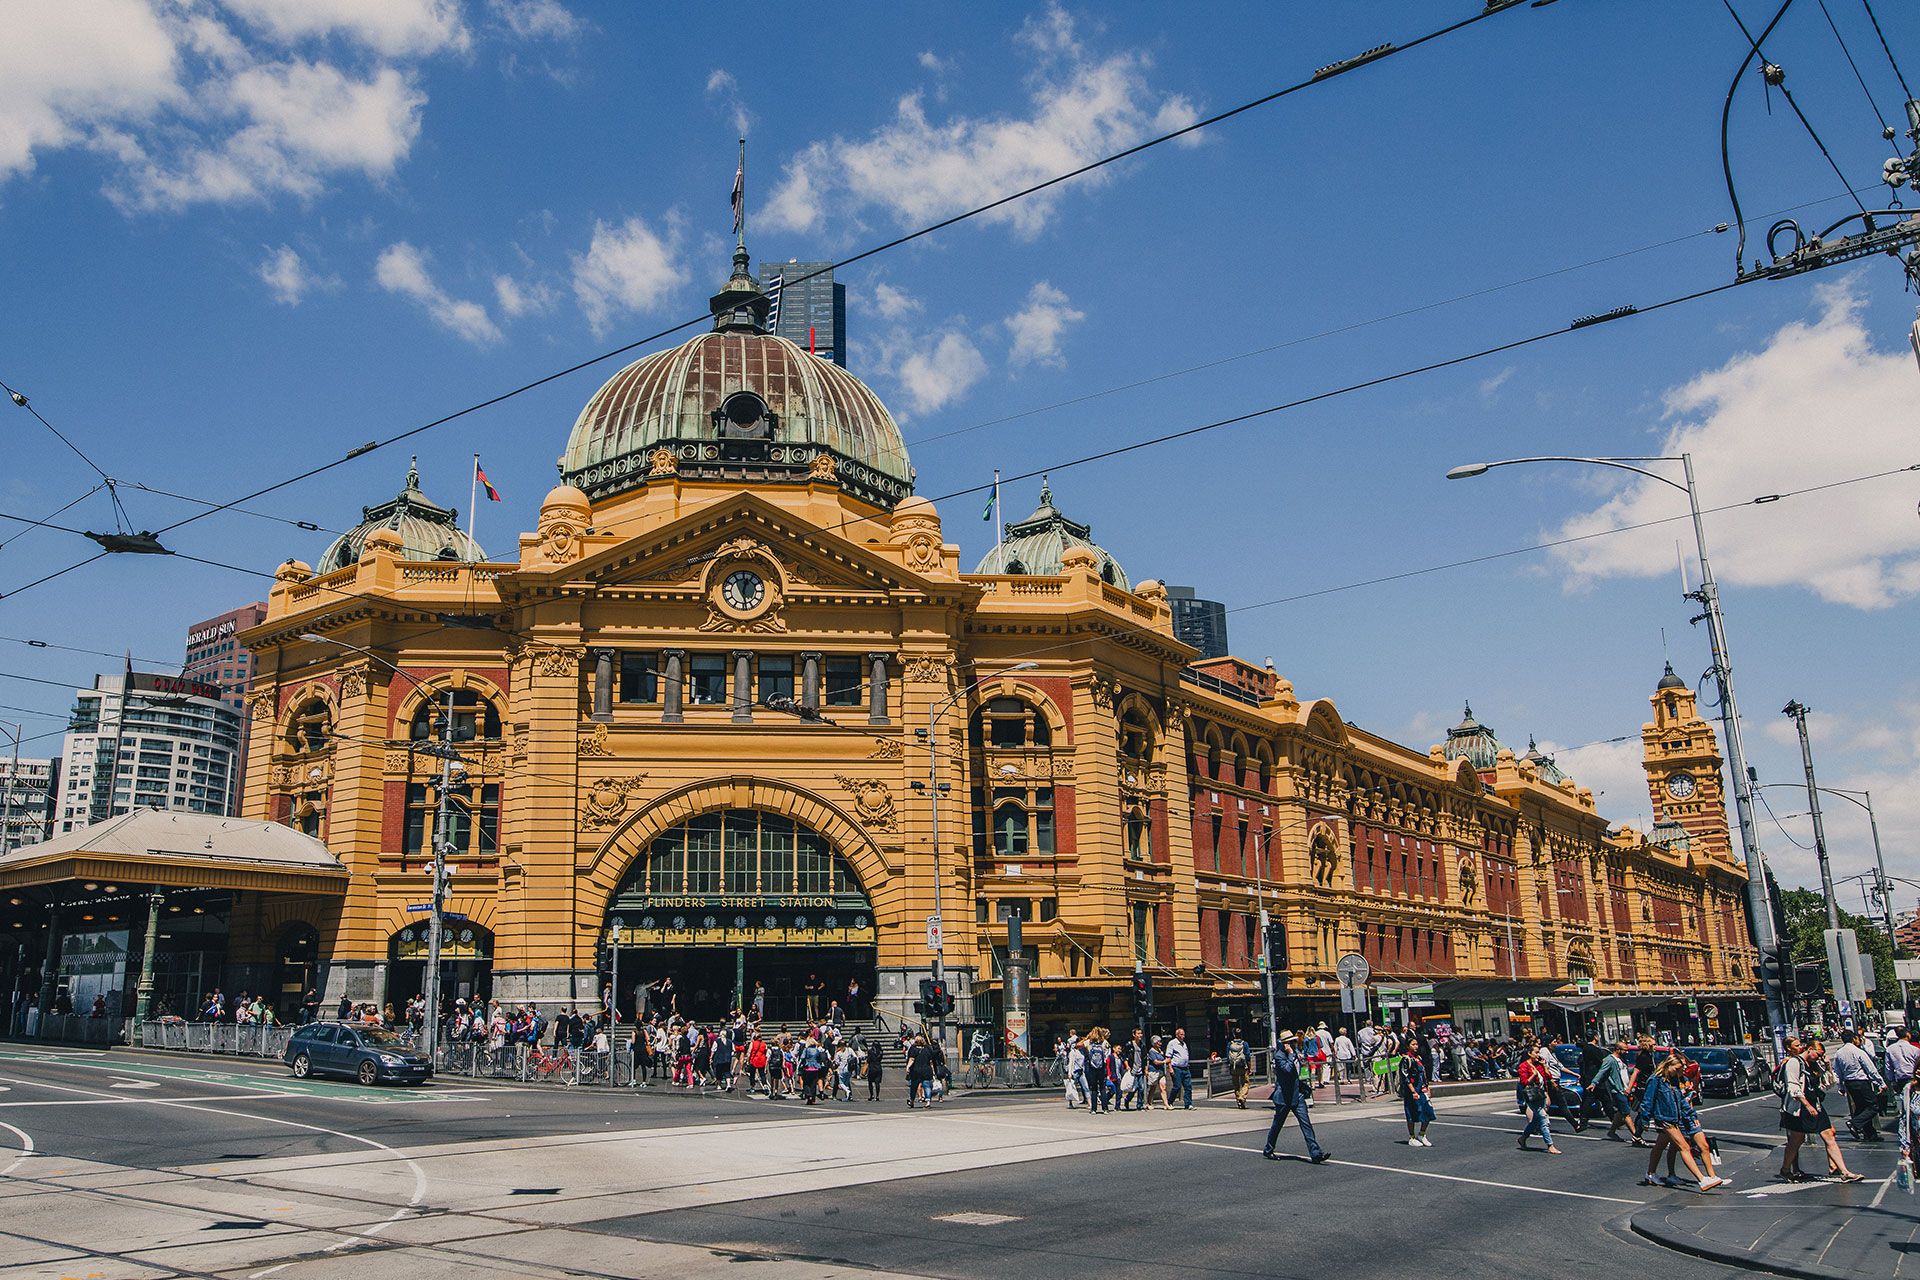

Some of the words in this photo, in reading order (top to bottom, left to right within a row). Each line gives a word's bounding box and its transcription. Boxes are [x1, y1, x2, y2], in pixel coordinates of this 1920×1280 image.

[186, 627, 217, 646] HERALD
[219, 620, 236, 635] SUN
[648, 897, 706, 908] FLINDERS
[721, 897, 766, 908] STREET
[779, 897, 834, 908] STATION
